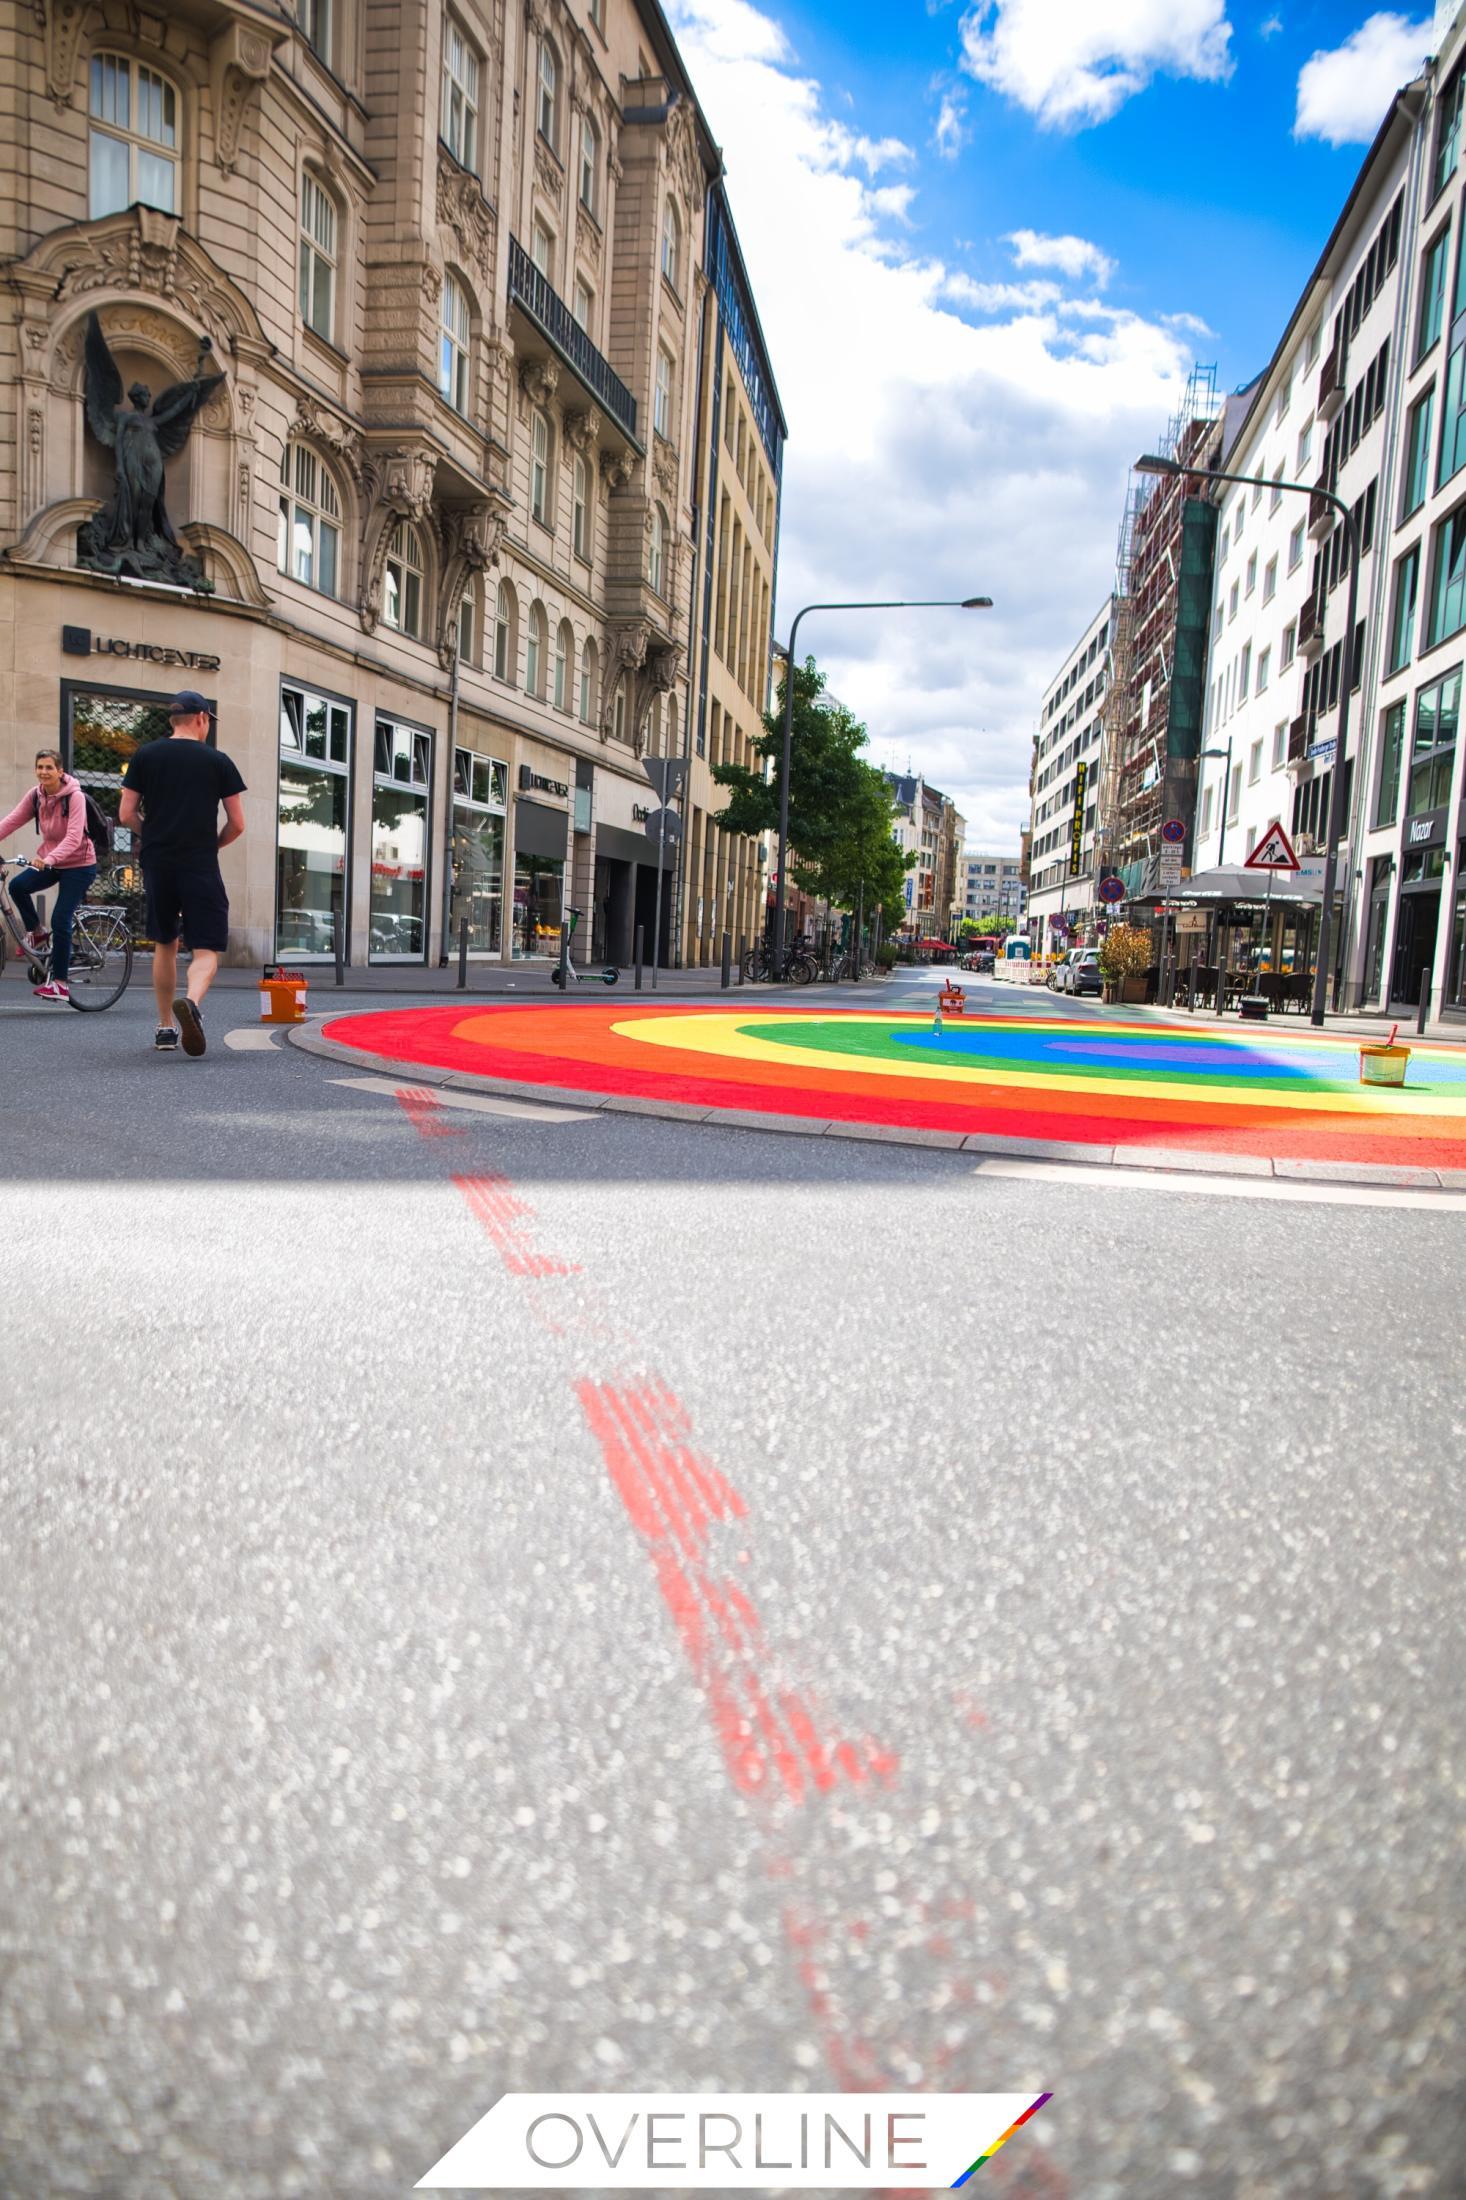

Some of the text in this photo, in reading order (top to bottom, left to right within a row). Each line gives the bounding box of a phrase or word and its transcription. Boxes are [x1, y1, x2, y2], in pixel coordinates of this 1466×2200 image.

[96, 637, 221, 671] LICHTCENTER
[1072, 810, 1082, 873] PROFIS
[1410, 820, 1434, 843] Nazar
